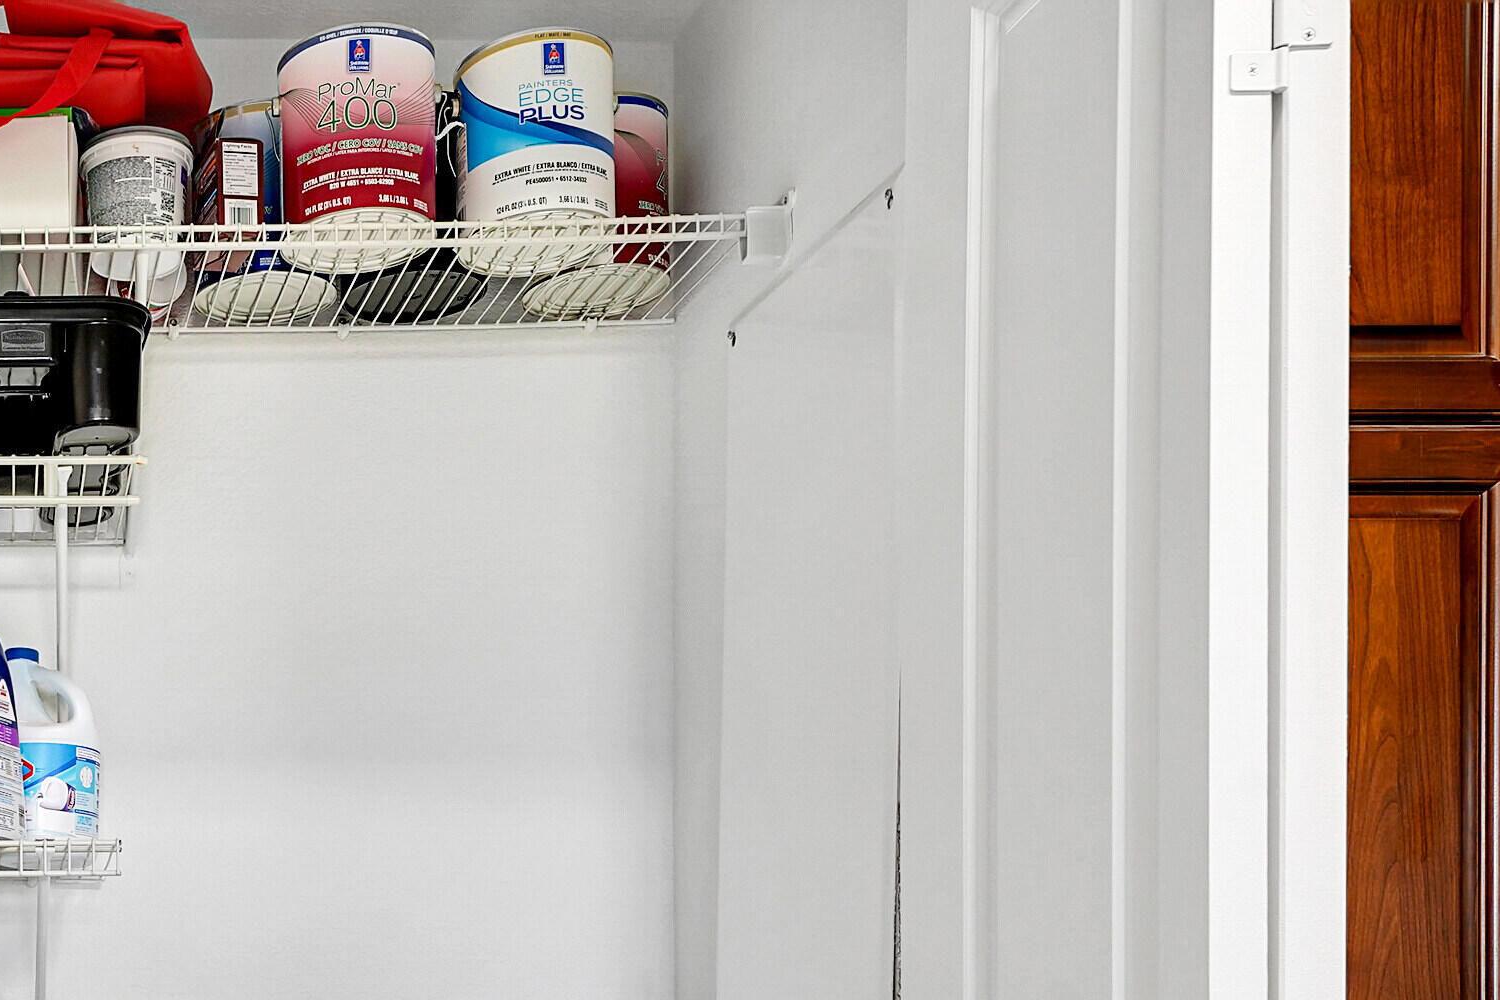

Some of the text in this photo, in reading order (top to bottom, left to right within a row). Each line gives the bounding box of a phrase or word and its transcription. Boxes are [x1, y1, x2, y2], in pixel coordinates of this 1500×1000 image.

[317, 77, 396, 102] ProMar
[518, 79, 573, 91] PAINTERS
[519, 87, 585, 107] EDGE
[316, 96, 398, 133] 400
[520, 105, 586, 124] PLUS
[338, 138, 360, 150] CERO
[303, 178, 318, 189] EXTRA
[318, 172, 336, 182] WHITE
[340, 168, 360, 176] EXTRA
[387, 168, 404, 177] EXTRA
[494, 170, 512, 182] EXTRA
[513, 164, 531, 175] WHITE
[581, 163, 596, 171] EXTRA
